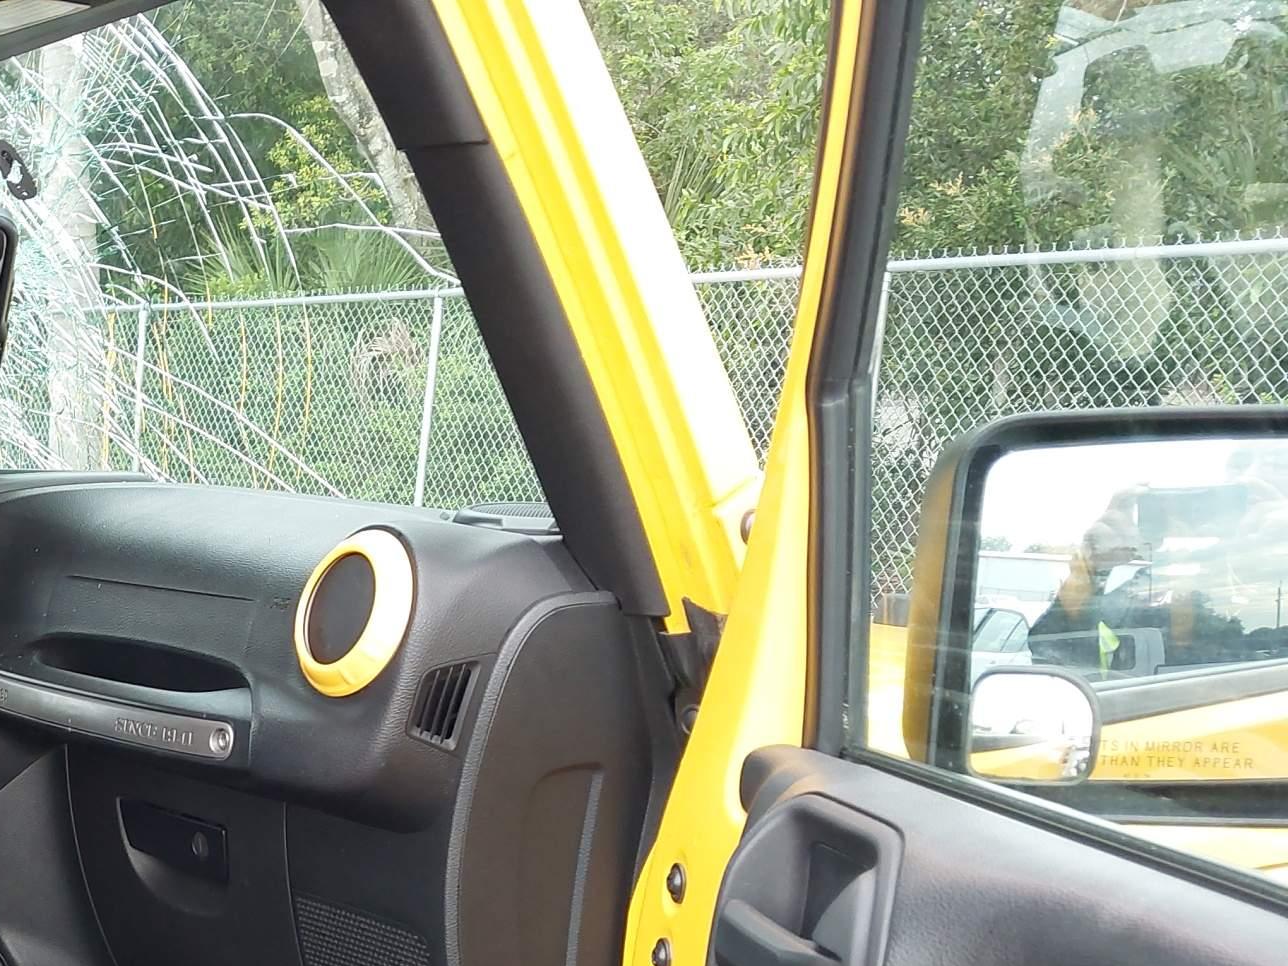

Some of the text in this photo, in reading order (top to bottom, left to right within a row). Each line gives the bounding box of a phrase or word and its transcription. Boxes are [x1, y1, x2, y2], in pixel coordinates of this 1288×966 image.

[1124, 740, 1138, 752] IN
[1145, 741, 1202, 753] MIRROR
[1211, 742, 1240, 754] ARE
[1101, 755, 1254, 769] THAN THEY APPEAR
